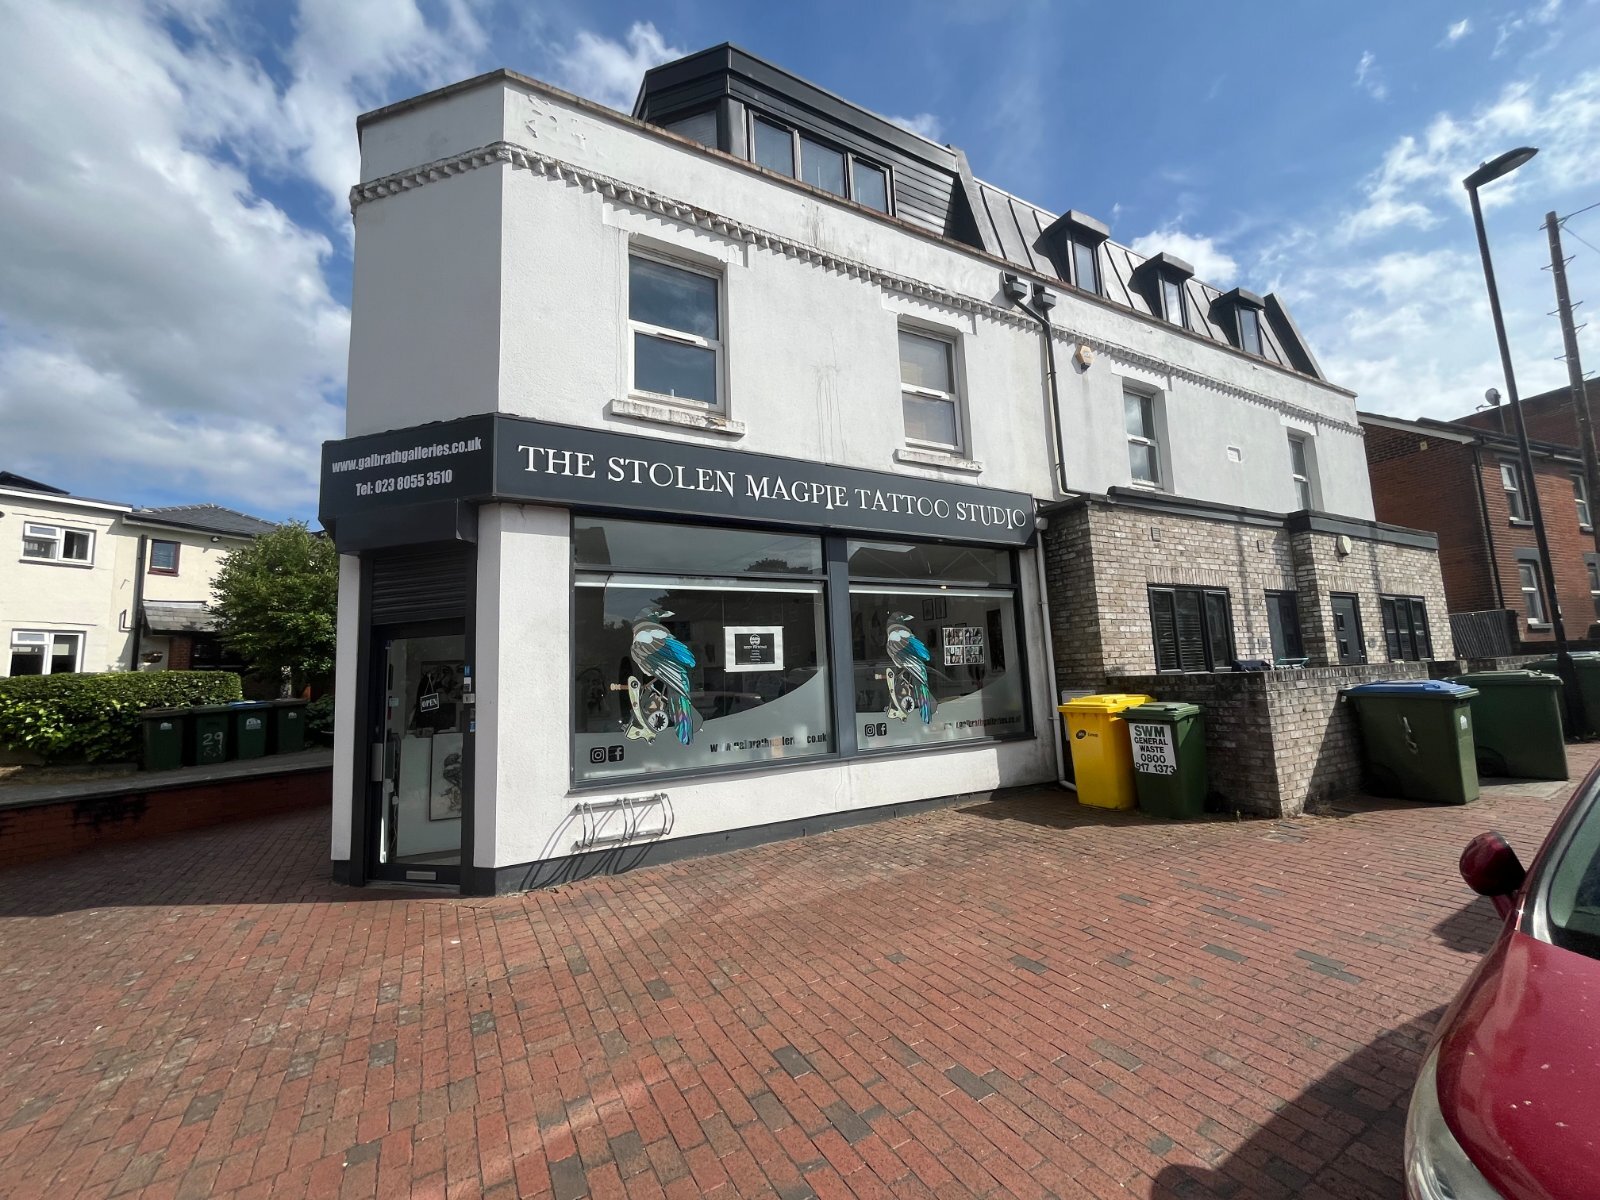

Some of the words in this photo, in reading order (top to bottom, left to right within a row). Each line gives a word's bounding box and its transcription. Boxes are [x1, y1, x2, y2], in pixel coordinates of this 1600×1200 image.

[332, 437, 482, 473] www.galbrathgalleries.co.uk
[356, 482, 373, 496] Tel:
[375, 478, 395, 494] 023
[397, 473, 425, 491] 8055
[427, 469, 453, 486] 3510
[518, 445, 596, 479] THE
[608, 457, 735, 498] STOLEN
[745, 474, 849, 510] MAGPIE
[854, 488, 950, 519] TATTOO
[956, 502, 1027, 530] STUDIO
[1134, 725, 1166, 737] SWM
[1134, 736, 1168, 746] GENERAL
[1139, 745, 1165, 753] WASTE
[1140, 753, 1166, 764] 0800
[1135, 762, 1149, 772] 917
[1153, 764, 1176, 774] 1373
